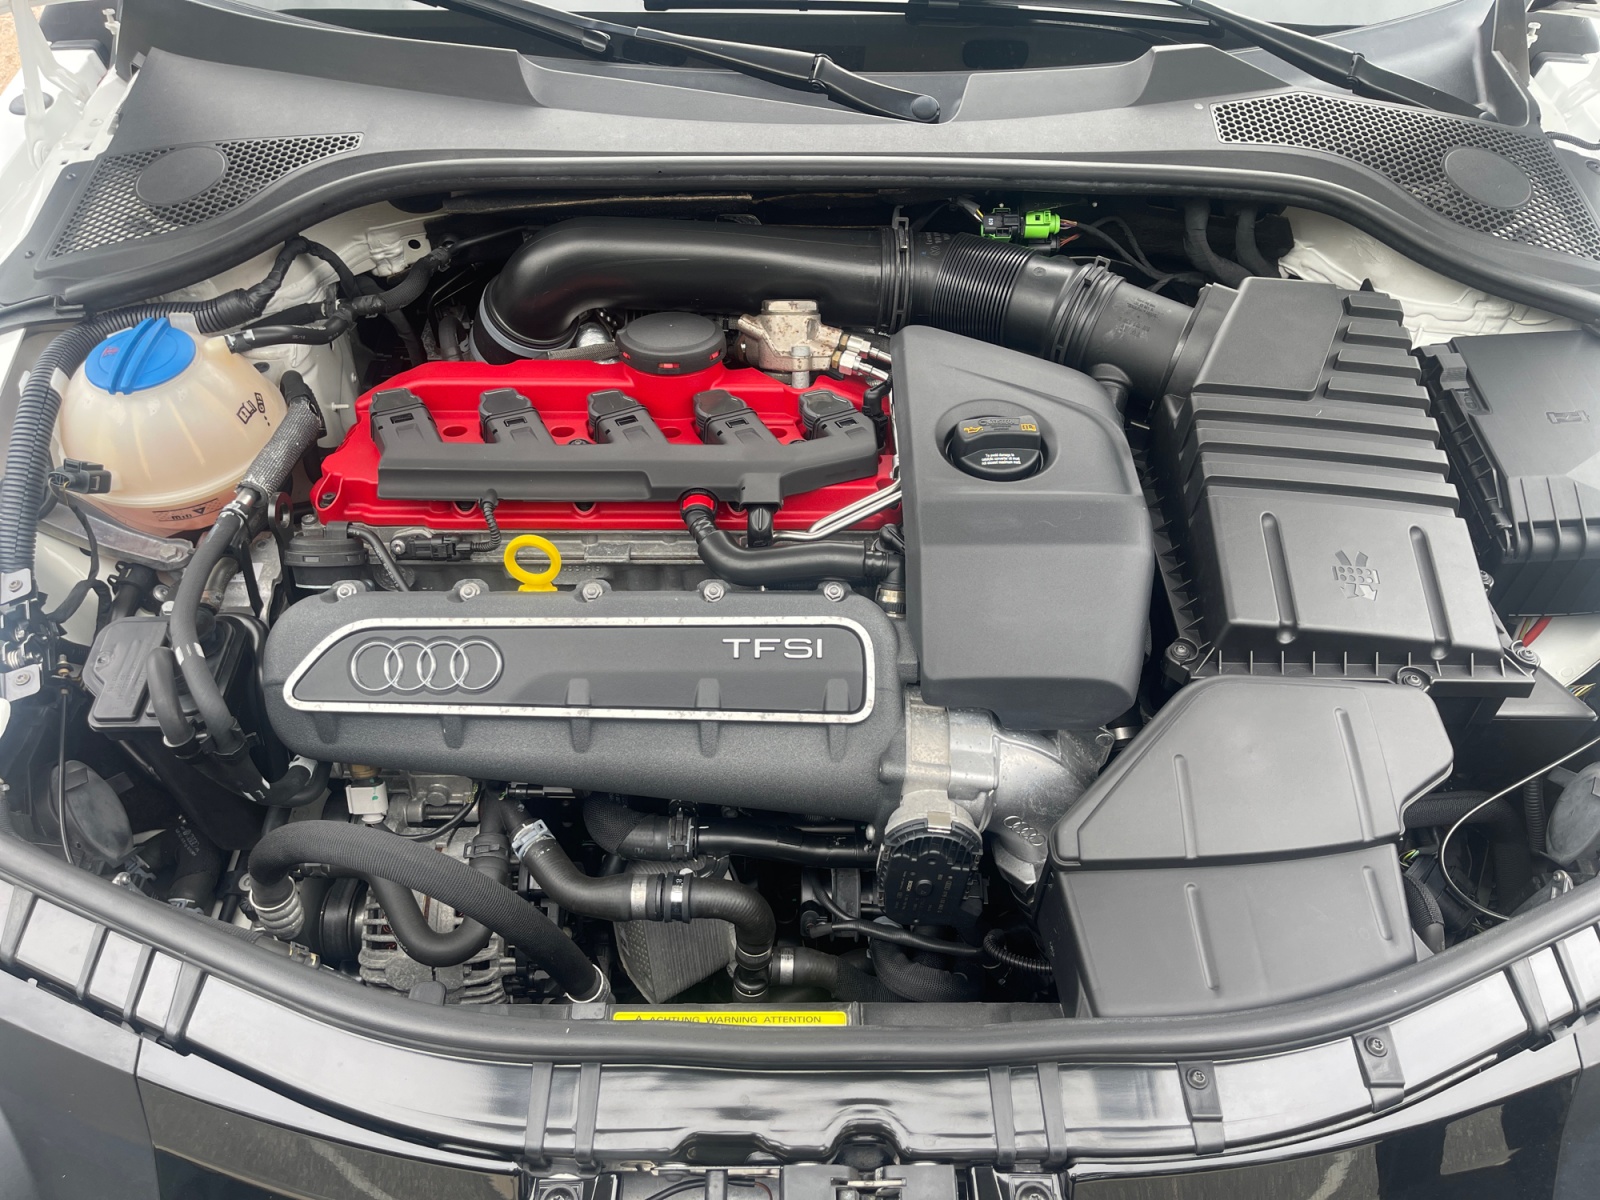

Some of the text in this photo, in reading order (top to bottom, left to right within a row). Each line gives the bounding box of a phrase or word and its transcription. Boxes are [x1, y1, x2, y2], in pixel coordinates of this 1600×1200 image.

[722, 638, 823, 659] TFSI
[705, 1016, 758, 1024] WARNING
[764, 1015, 822, 1024] ATTENTION
